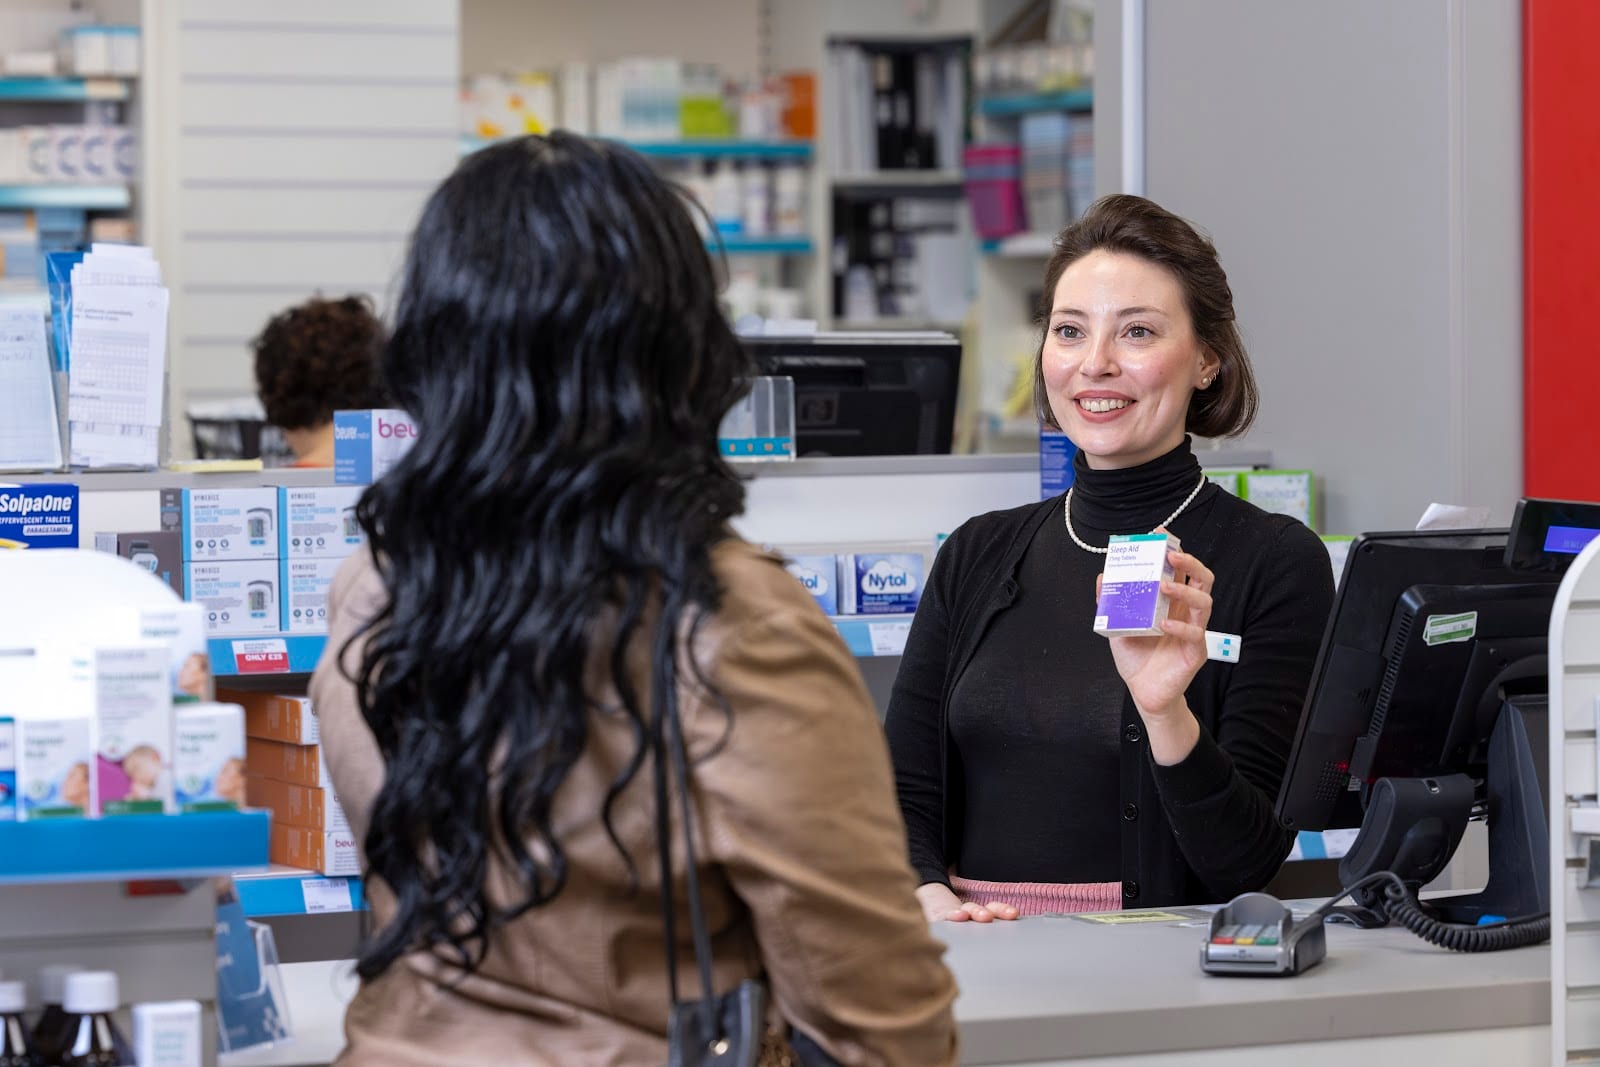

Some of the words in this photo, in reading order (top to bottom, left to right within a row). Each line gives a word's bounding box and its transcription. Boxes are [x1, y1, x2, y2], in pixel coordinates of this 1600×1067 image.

[378, 417, 418, 438] beu
[0, 494, 72, 516] SolpaOne
[45, 515, 71, 523] TABLETS
[26, 526, 70, 534] PARACETAMOL
[1110, 546, 1128, 554] Sleep
[800, 574, 818, 588] tol
[869, 572, 906, 590] Nytol
[245, 654, 267, 662] ONLY
